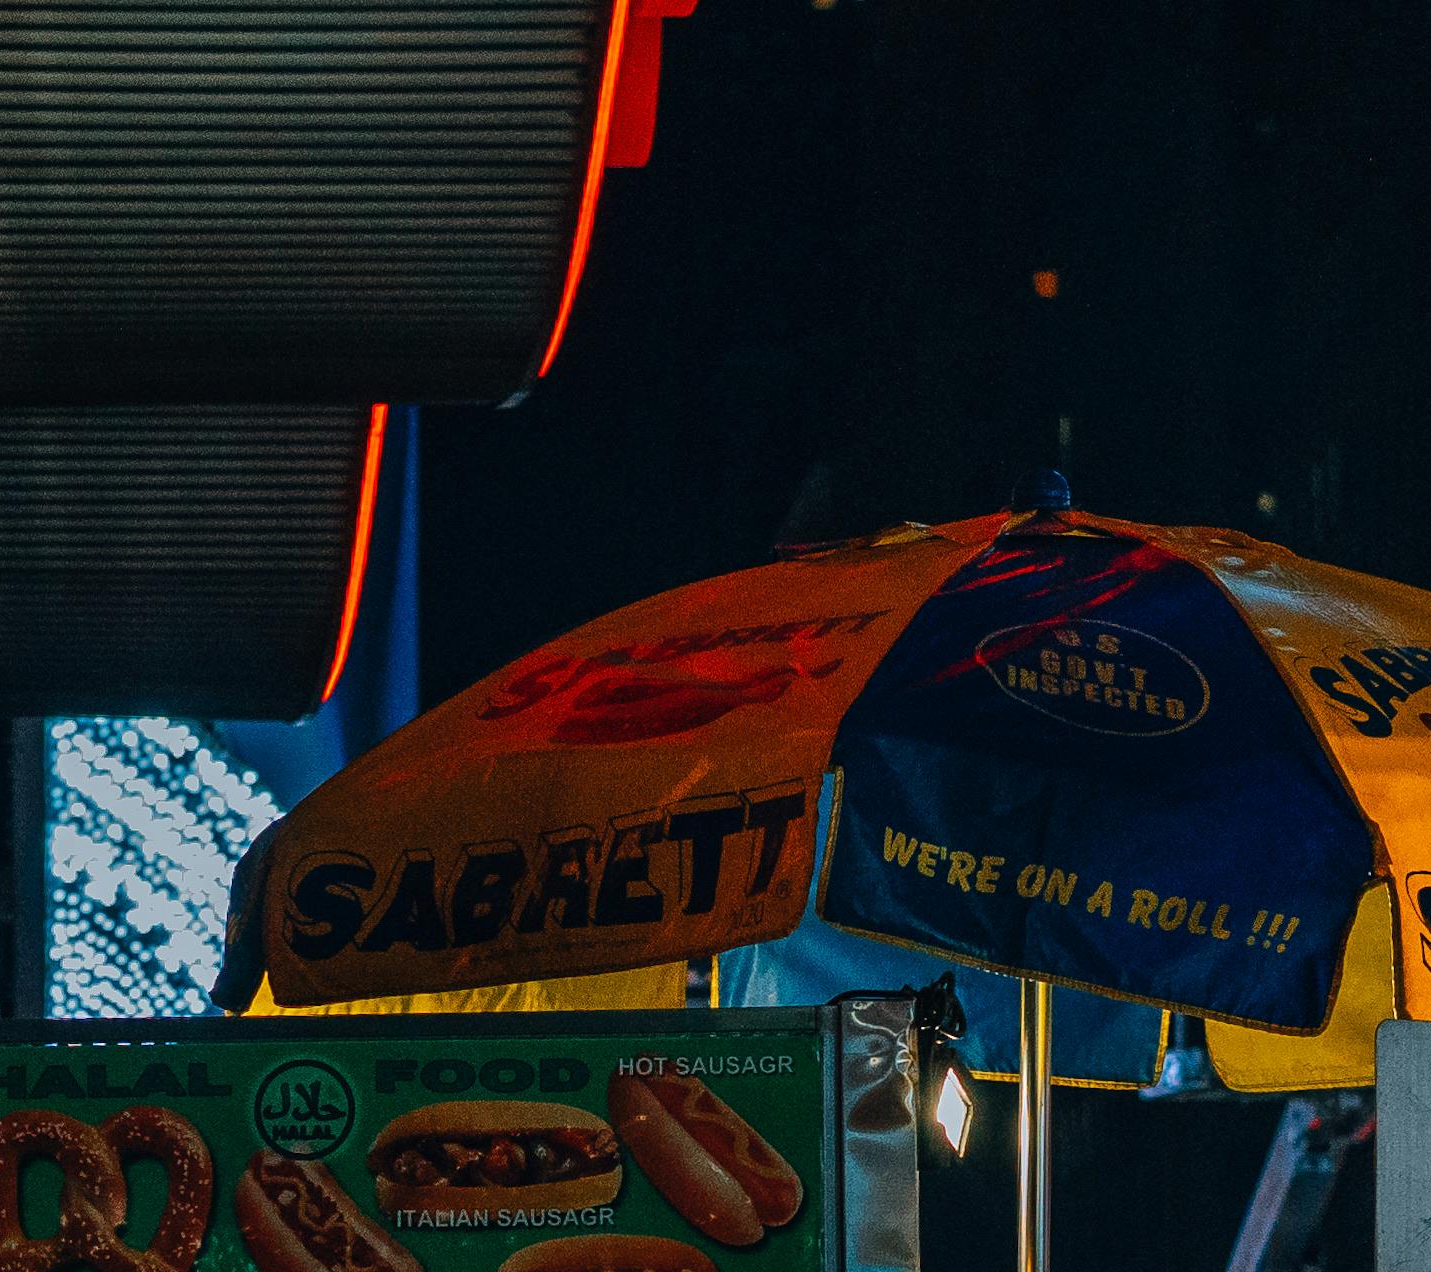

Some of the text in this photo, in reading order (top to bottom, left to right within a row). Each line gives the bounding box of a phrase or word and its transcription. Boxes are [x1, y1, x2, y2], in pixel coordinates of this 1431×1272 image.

[1005, 663, 1188, 722] INSPECTED
[281, 776, 807, 961] SABRETT
[882, 826, 1006, 894] WE'RE
[1016, 863, 1078, 906] ON
[1086, 880, 1115, 918] A
[1127, 888, 1232, 940] ROLL
[375, 1058, 591, 1095] FOOD
[618, 1055, 795, 1078] HOT SAUSAGR
[271, 1125, 337, 1142] HALAL
[395, 1207, 616, 1229] ITALIAN SAUSAGR
